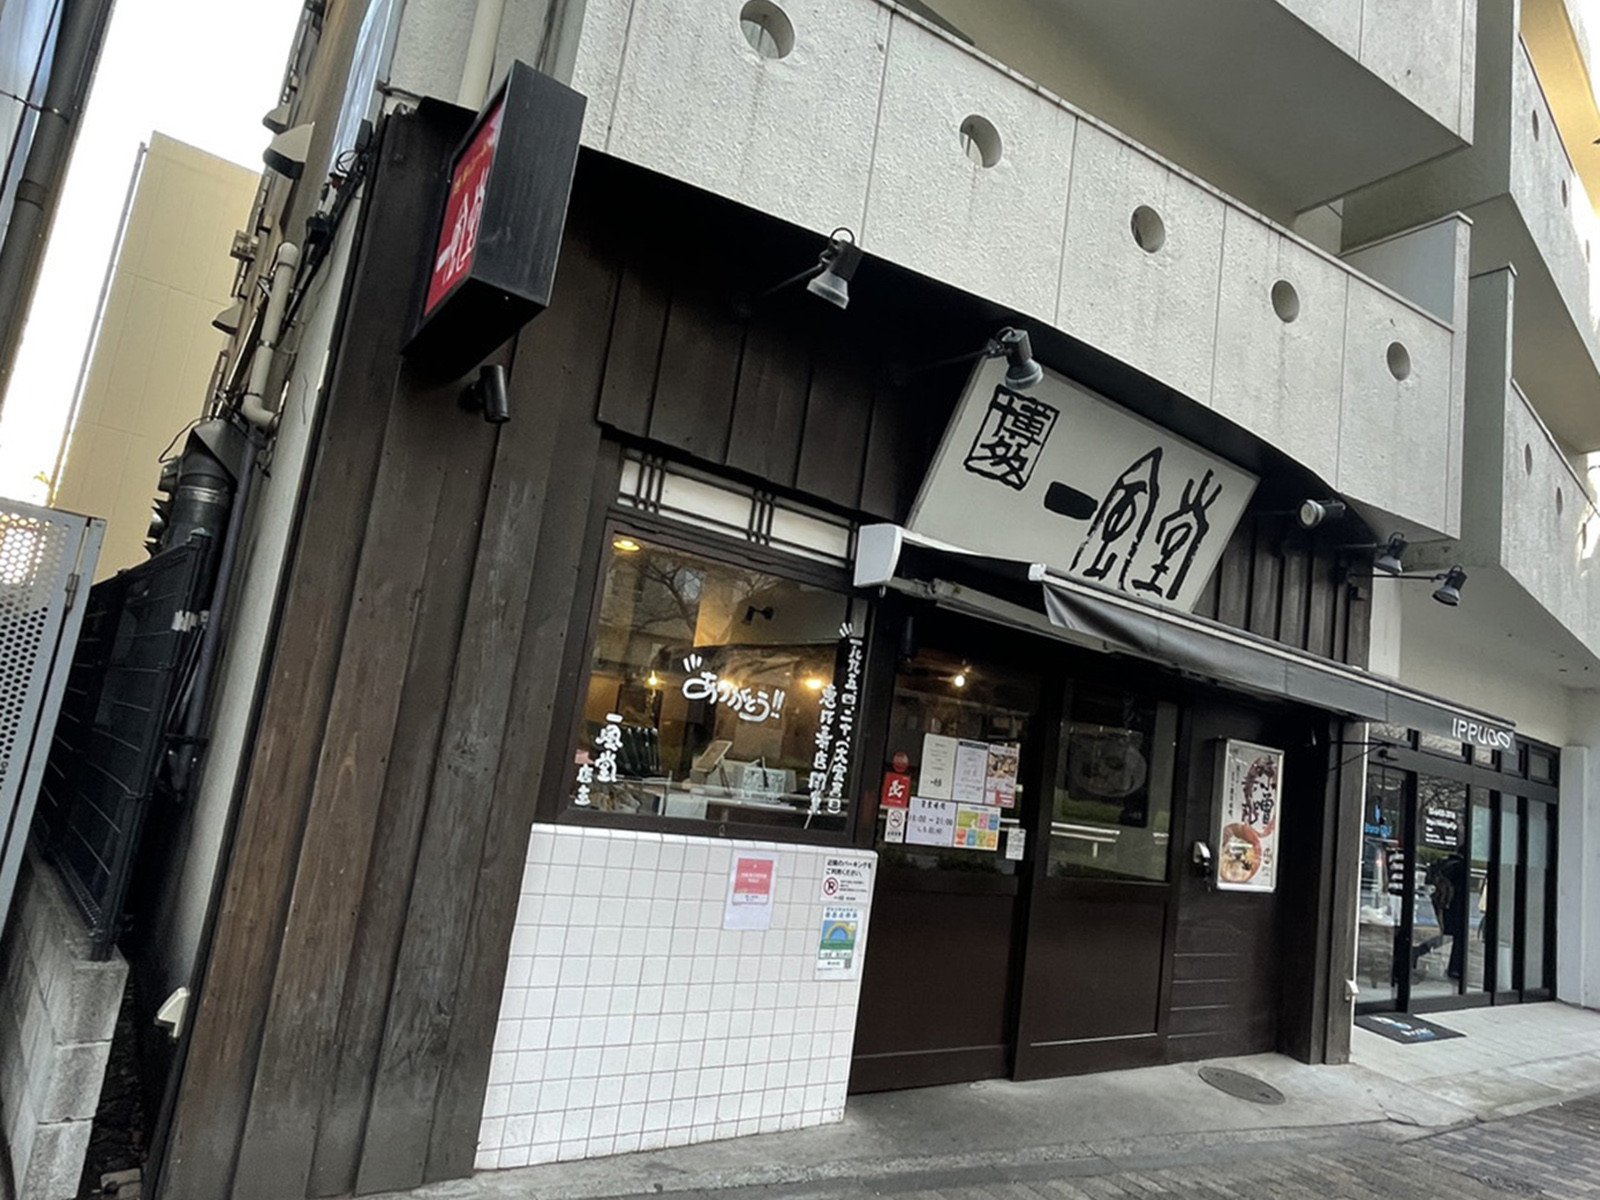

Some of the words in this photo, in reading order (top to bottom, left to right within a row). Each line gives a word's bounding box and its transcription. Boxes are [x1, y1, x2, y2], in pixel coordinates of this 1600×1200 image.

[964, 384, 1060, 491] 博多
[1044, 446, 1222, 600] 一風堂
[595, 713, 623, 782] 一風堂
[1452, 718, 1511, 749] IPPUDO
[574, 764, 594, 806] 店主
